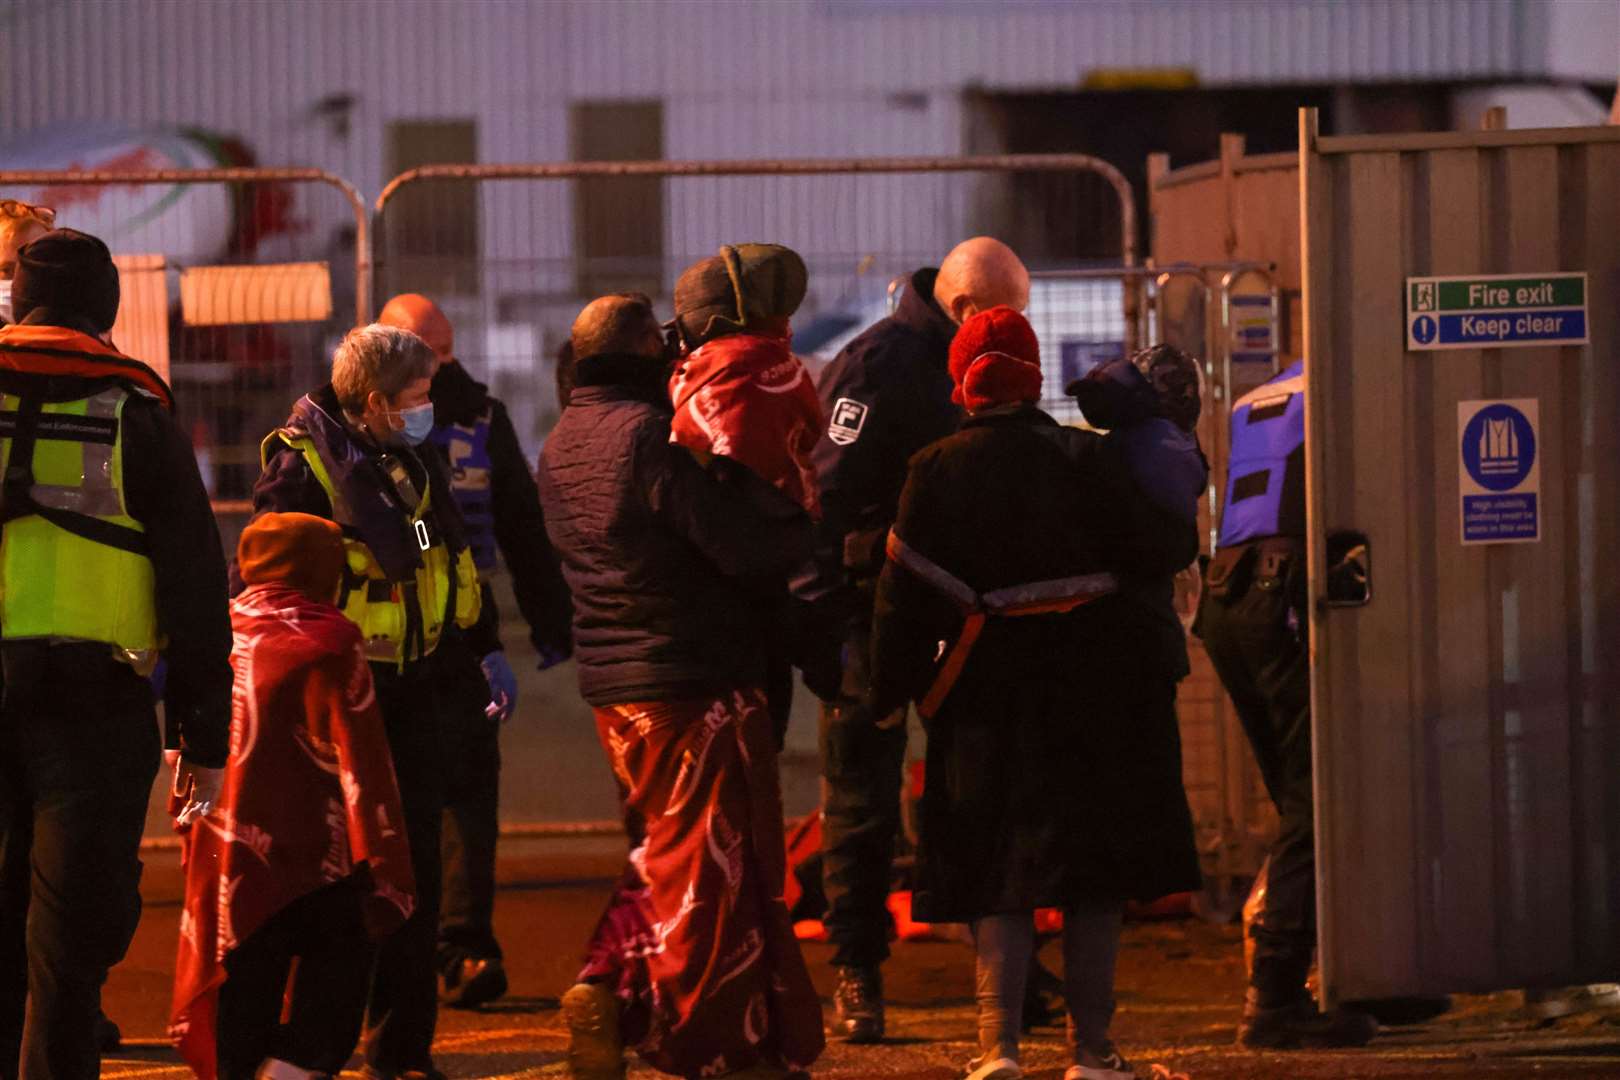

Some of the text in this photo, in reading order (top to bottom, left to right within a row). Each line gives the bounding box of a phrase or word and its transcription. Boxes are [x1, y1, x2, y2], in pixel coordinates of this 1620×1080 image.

[1468, 282, 1554, 306] Fire exit
[1461, 314, 1564, 339] Keep clear
